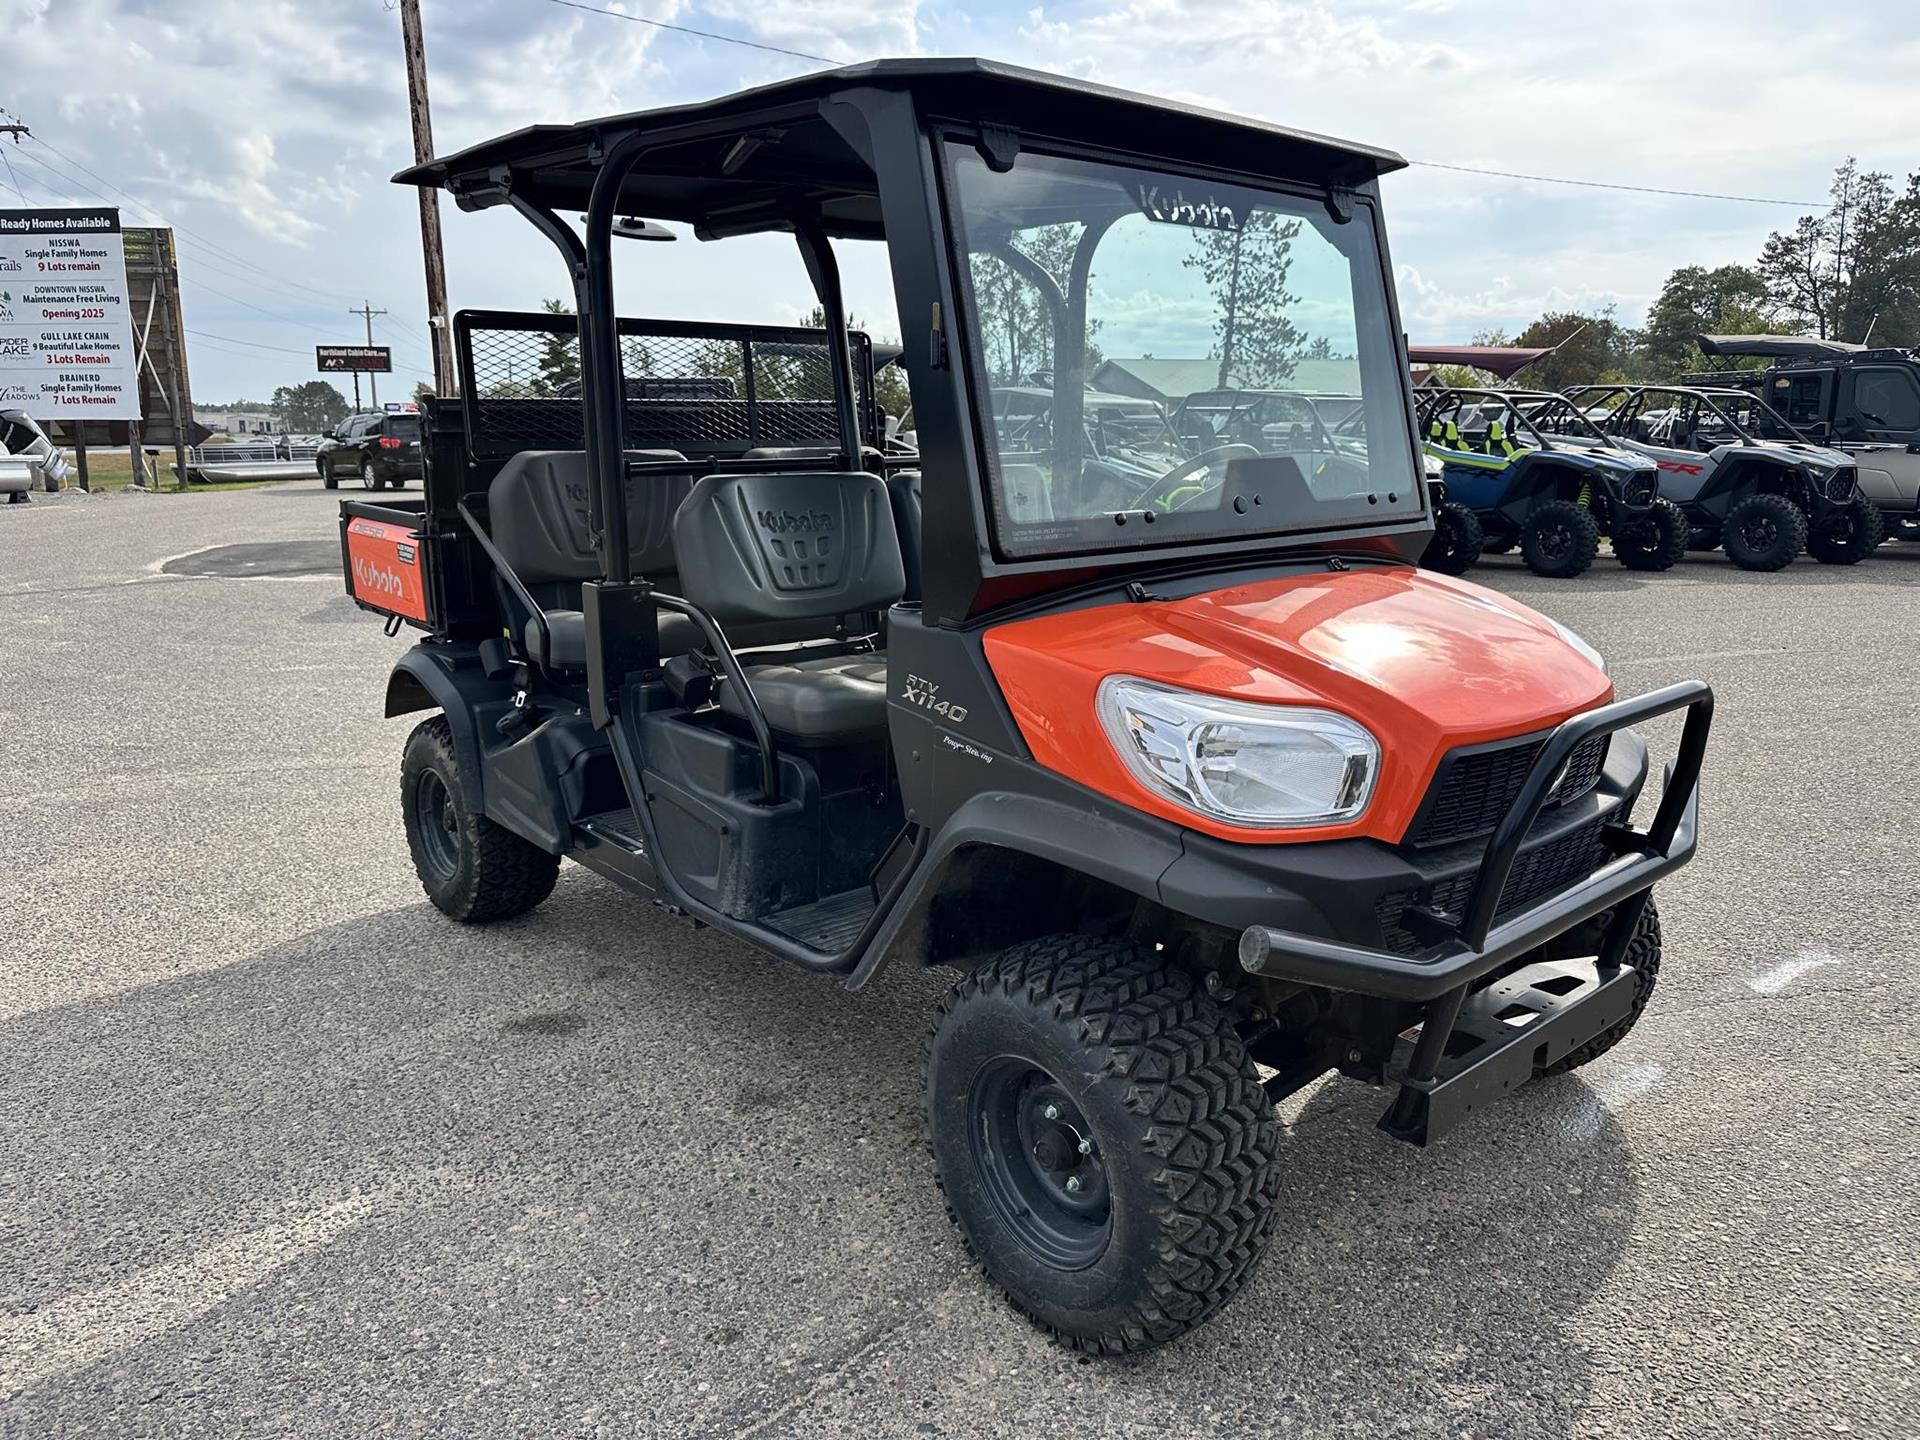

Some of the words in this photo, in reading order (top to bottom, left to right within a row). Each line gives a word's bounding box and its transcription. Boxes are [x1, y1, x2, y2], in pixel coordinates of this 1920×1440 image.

[1139, 184, 1239, 230] Kubota
[0, 218, 30, 231] Ready
[32, 218, 64, 229] Homes
[66, 217, 111, 228] Available
[49, 239, 80, 247] NISSWA
[25, 249, 50, 260] Single
[51, 249, 78, 259] Family
[79, 249, 107, 257] Homes
[38, 262, 45, 272] 9
[47, 262, 66, 271] Lots
[68, 261, 100, 271] remain
[34, 286, 76, 294] DOWNTOWN
[23, 295, 75, 304] Maintenance
[76, 295, 94, 303] Free
[95, 294, 120, 304] Living
[42, 309, 80, 320] Opening
[81, 309, 105, 318] 2025
[40, 332, 60, 340] GULL
[62, 332, 82, 340] LAKE
[84, 332, 110, 340] CHAIN
[32, 342, 38, 351] 9
[39, 342, 74, 351] Beautiful
[75, 342, 93, 350] Lake
[94, 342, 121, 350] Homes
[46, 355, 53, 364] 3
[54, 355, 74, 364] Lots
[75, 354, 111, 364] Remain
[59, 374, 101, 382] BRAINERD
[40, 384, 66, 394] Single
[67, 384, 93, 394] Family
[94, 384, 122, 392] Homes
[52, 396, 59, 405] 7
[62, 396, 81, 405] Lots
[82, 395, 116, 405] Remain
[757, 509, 834, 534] Kubota
[354, 556, 404, 599] Kubota
[906, 673, 940, 695] RTV
[901, 684, 968, 723] X1140
